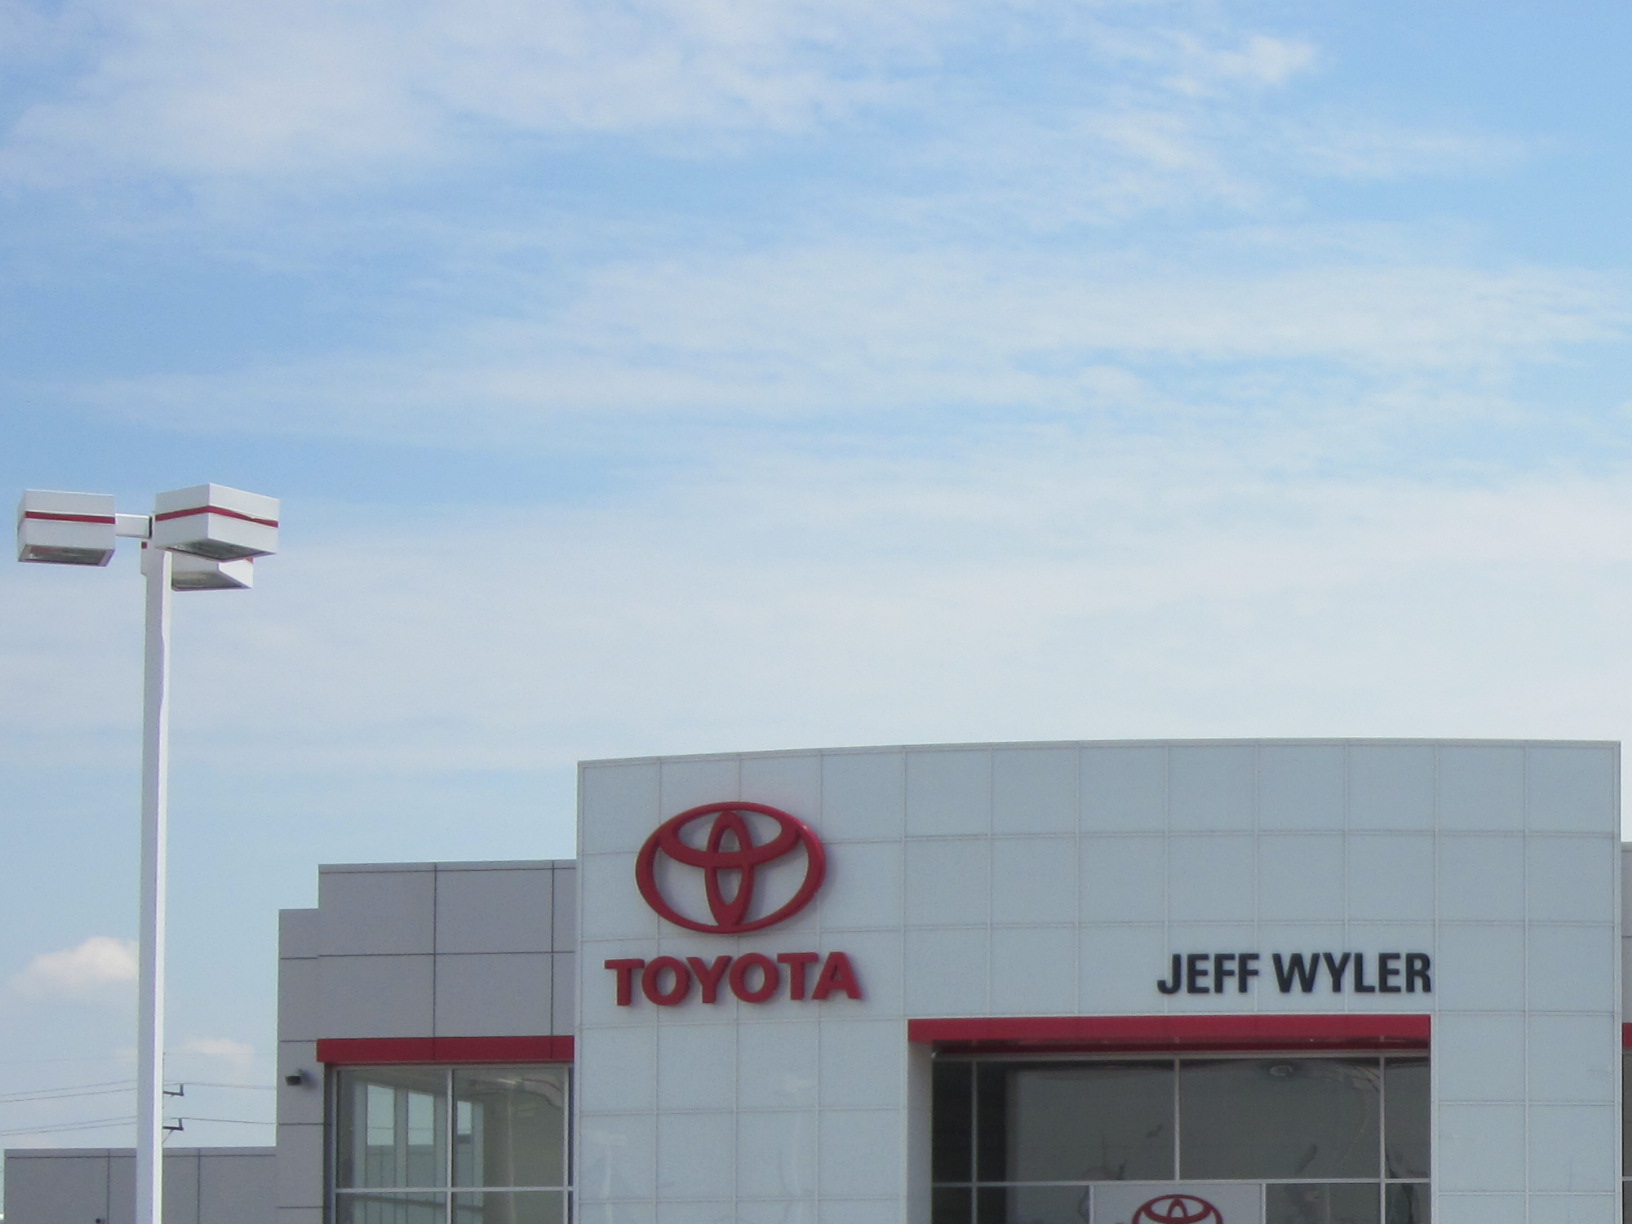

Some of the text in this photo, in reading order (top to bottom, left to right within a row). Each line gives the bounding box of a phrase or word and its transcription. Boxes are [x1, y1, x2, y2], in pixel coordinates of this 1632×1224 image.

[604, 952, 862, 1007] TOYOTA
[1156, 952, 1432, 994] JEFF WYLER
